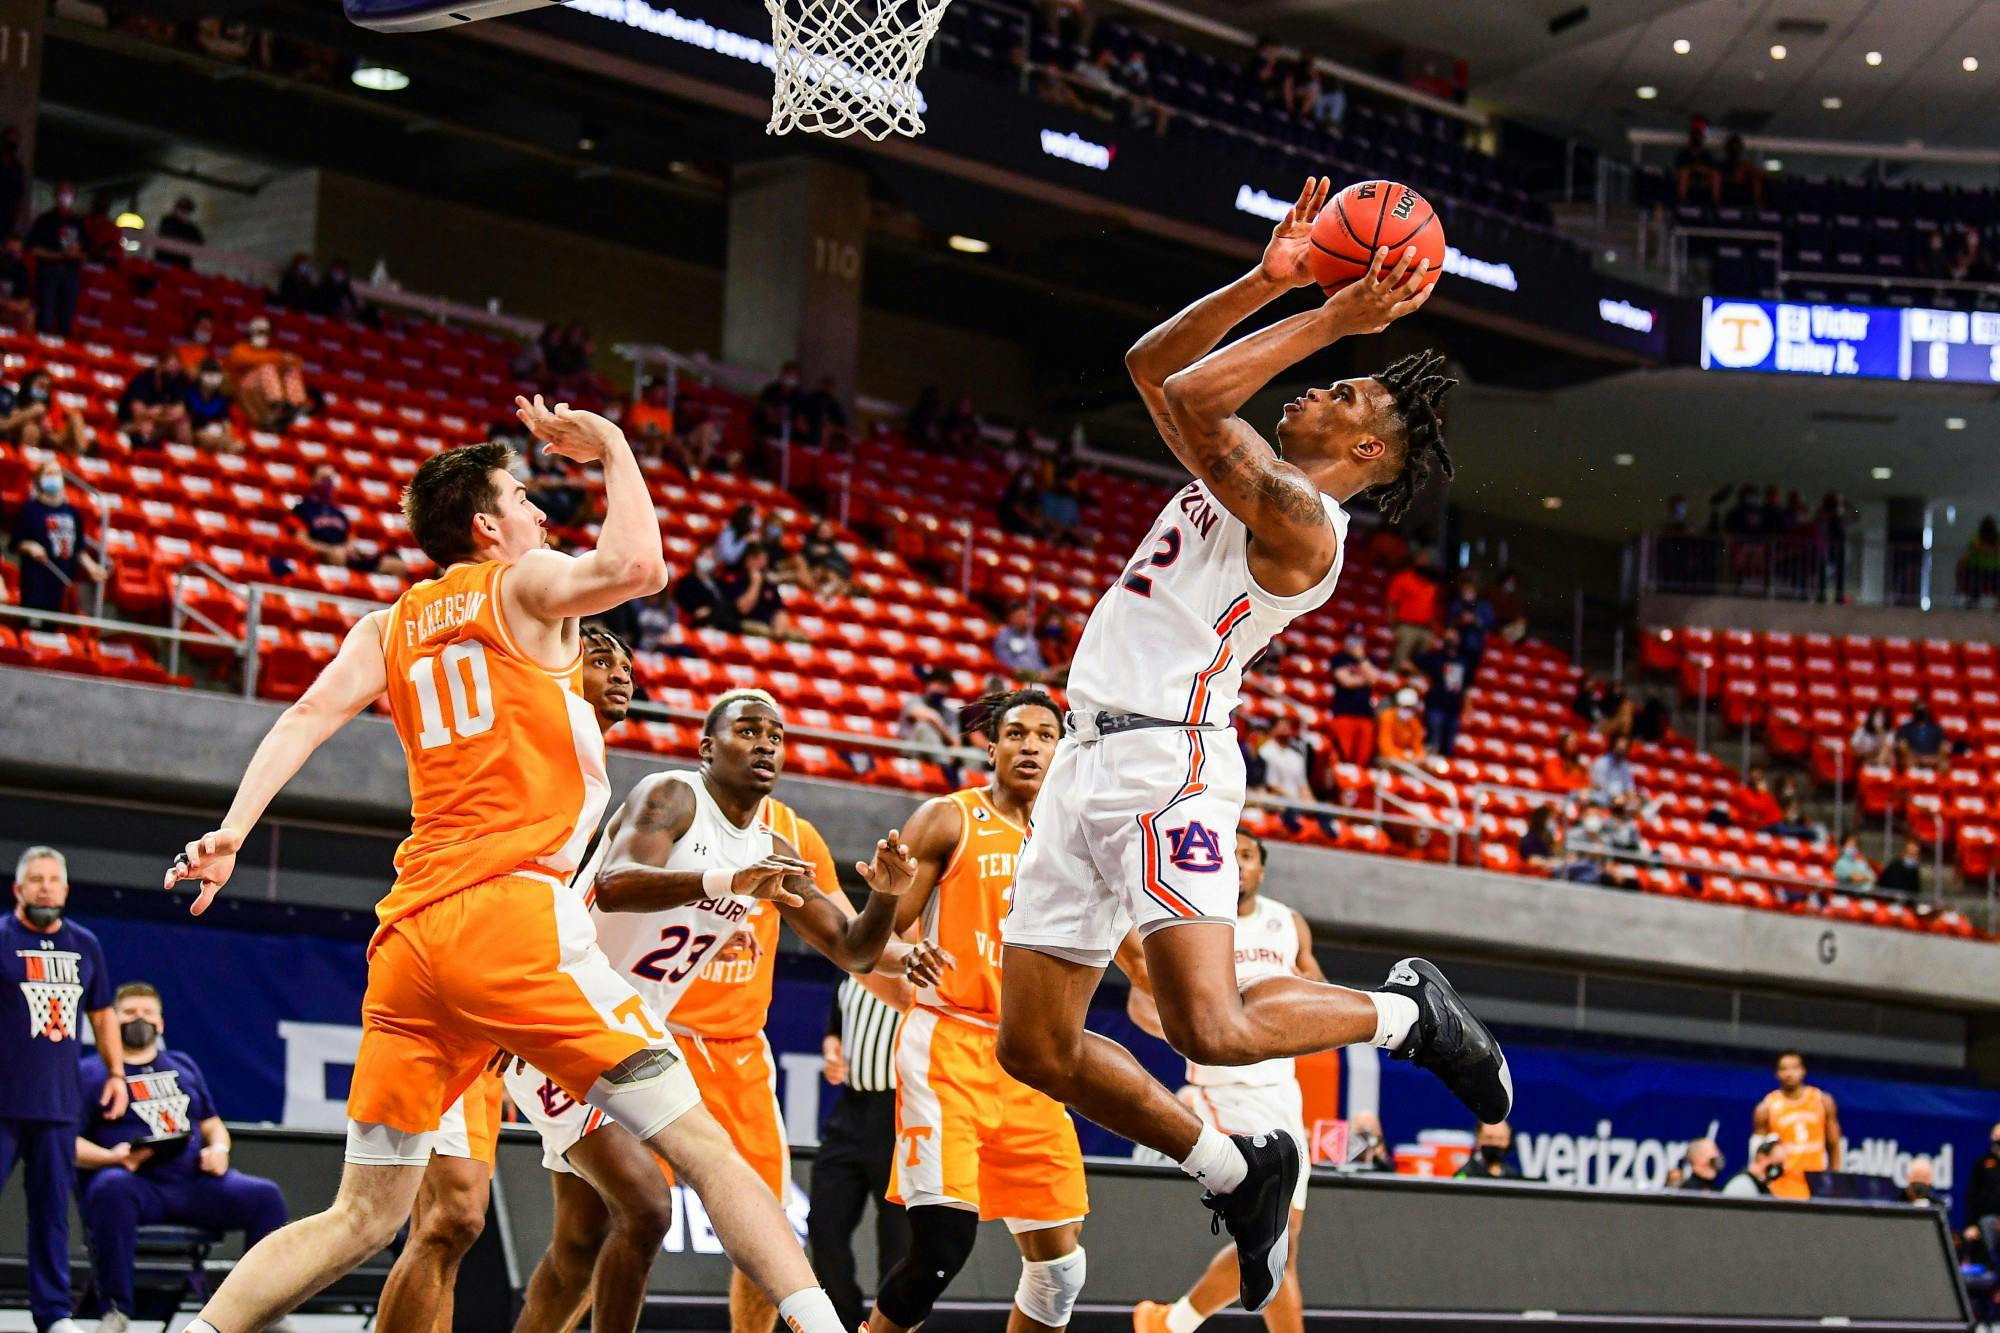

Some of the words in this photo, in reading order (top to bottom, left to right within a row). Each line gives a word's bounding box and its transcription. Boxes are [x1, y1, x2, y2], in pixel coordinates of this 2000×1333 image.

[815, 236, 861, 279] 110
[1811, 305, 1869, 341] Victor
[409, 638, 495, 750] 10
[1165, 821, 1223, 873] AU
[684, 897, 748, 922] BUR
[631, 925, 717, 983] 23
[1818, 929, 1837, 965] G
[612, 994, 665, 1039] T
[902, 1126, 933, 1168] T
